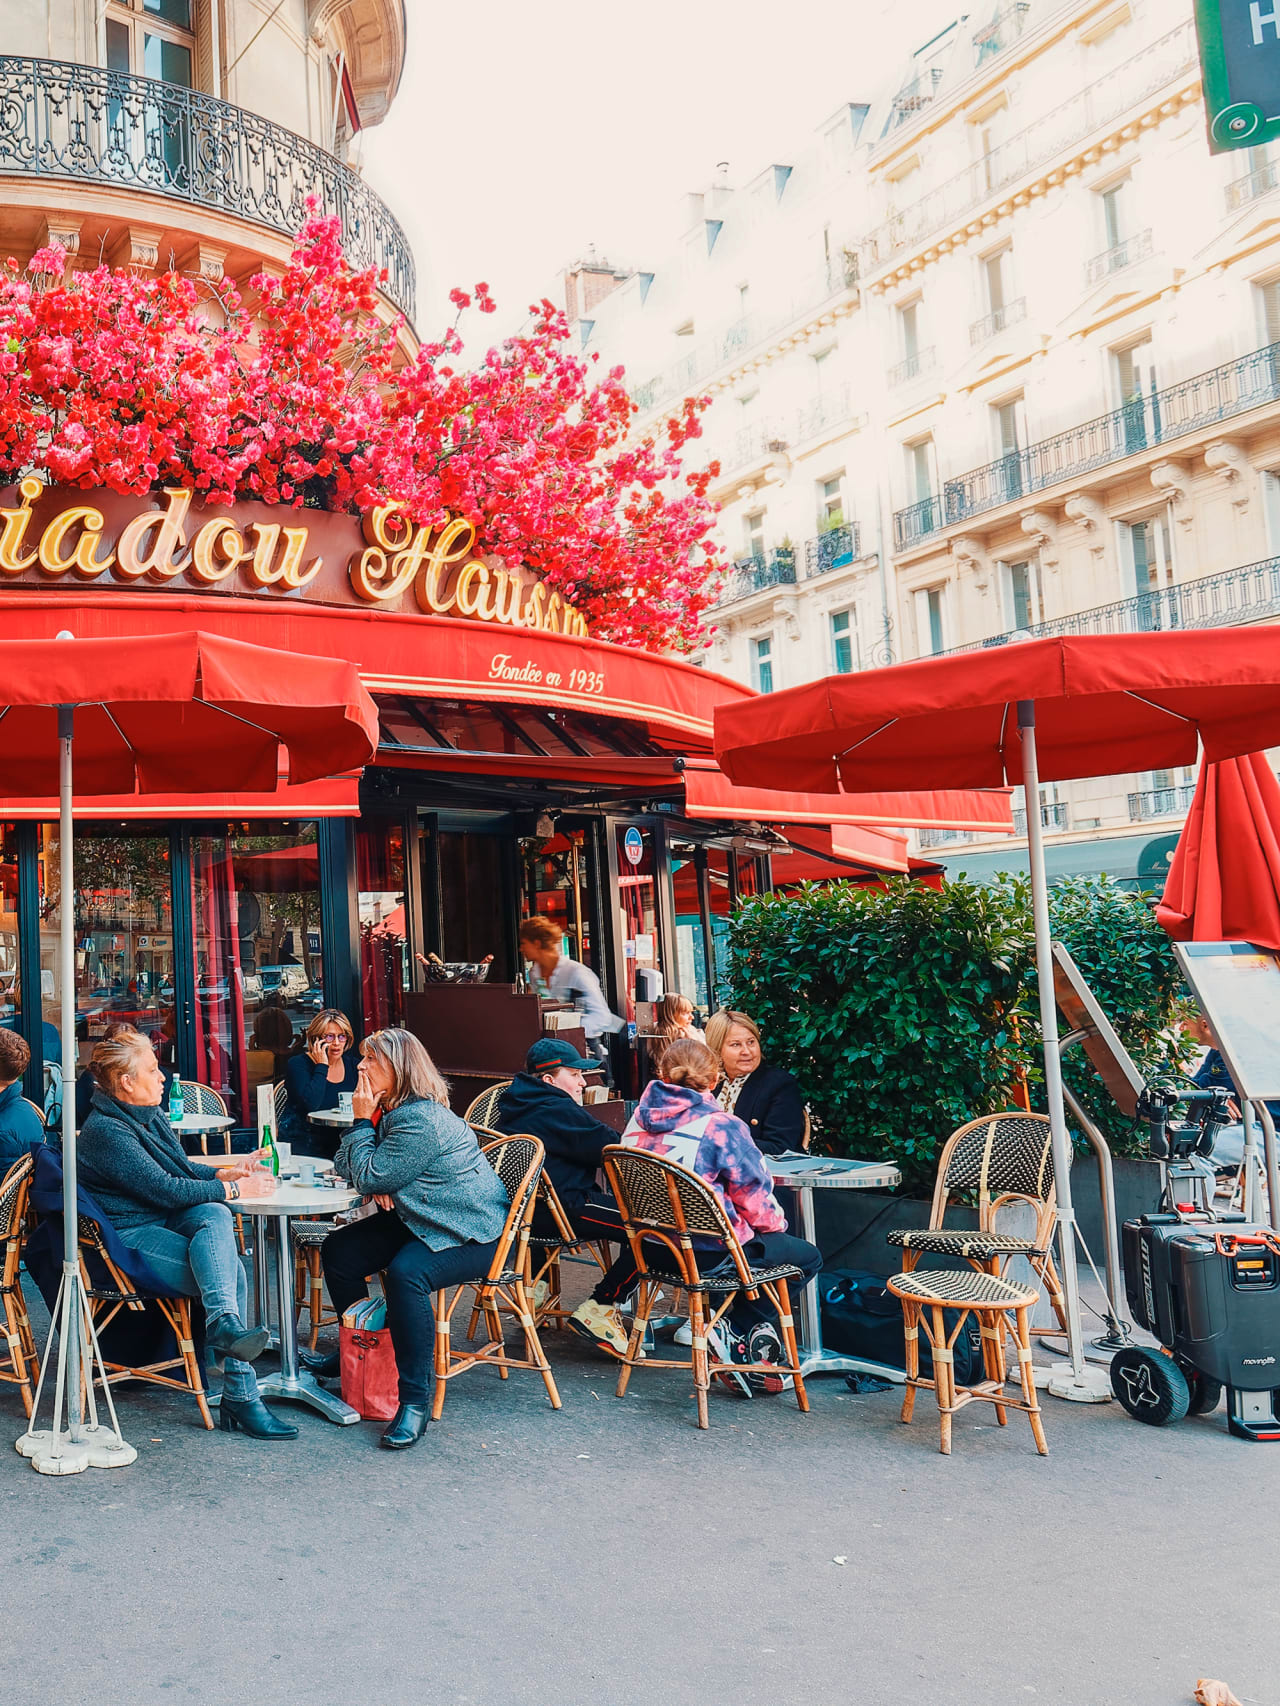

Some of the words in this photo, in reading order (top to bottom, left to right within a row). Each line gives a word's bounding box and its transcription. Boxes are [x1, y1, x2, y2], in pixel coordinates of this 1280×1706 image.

[488, 653, 542, 683] Fondée
[546, 672, 562, 686] en
[569, 669, 605, 694] 1935
